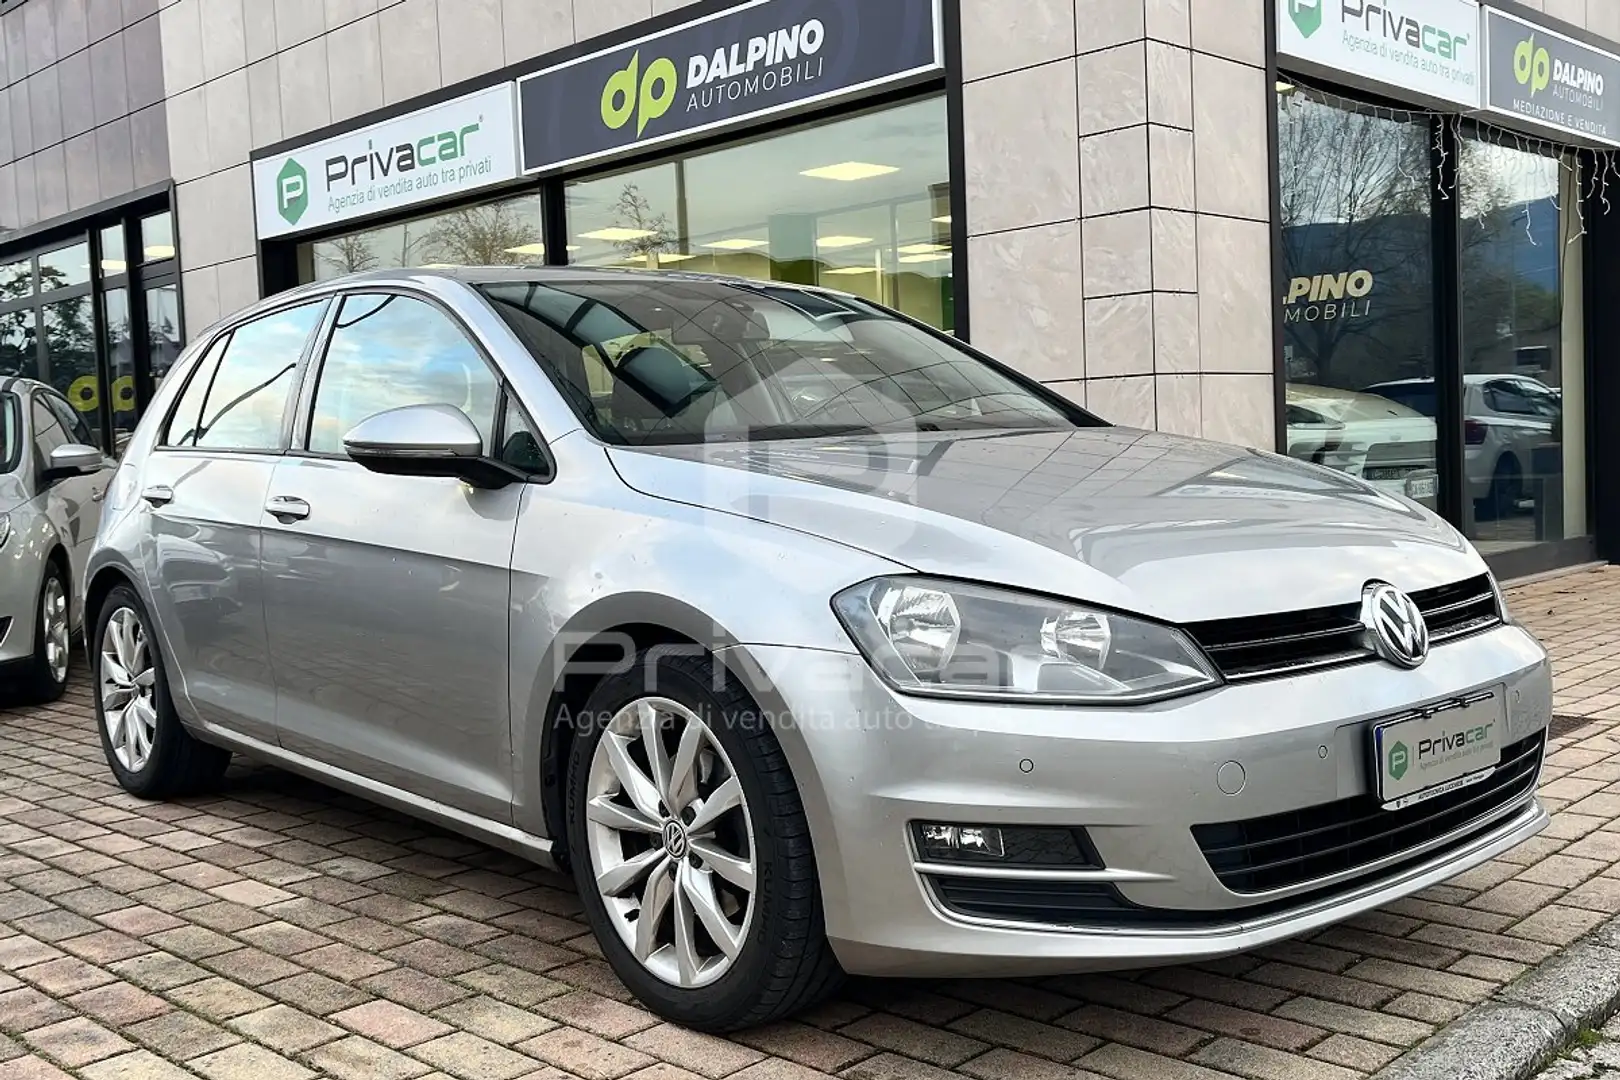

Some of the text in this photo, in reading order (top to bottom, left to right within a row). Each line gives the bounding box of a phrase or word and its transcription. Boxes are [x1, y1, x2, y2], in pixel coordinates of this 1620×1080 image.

[686, 19, 824, 89] DALPINO
[1552, 58, 1604, 96] DALPINO
[686, 57, 824, 112] AUTOMOBILI
[1552, 83, 1604, 112] AUTOMOBILI
[1513, 98, 1607, 136] MEDIAZIONE E VENDITA
[325, 122, 480, 192] Privacar
[328, 155, 492, 214] Agenzia di vendita auto tra privati
[1418, 722, 1493, 760] Privacar
